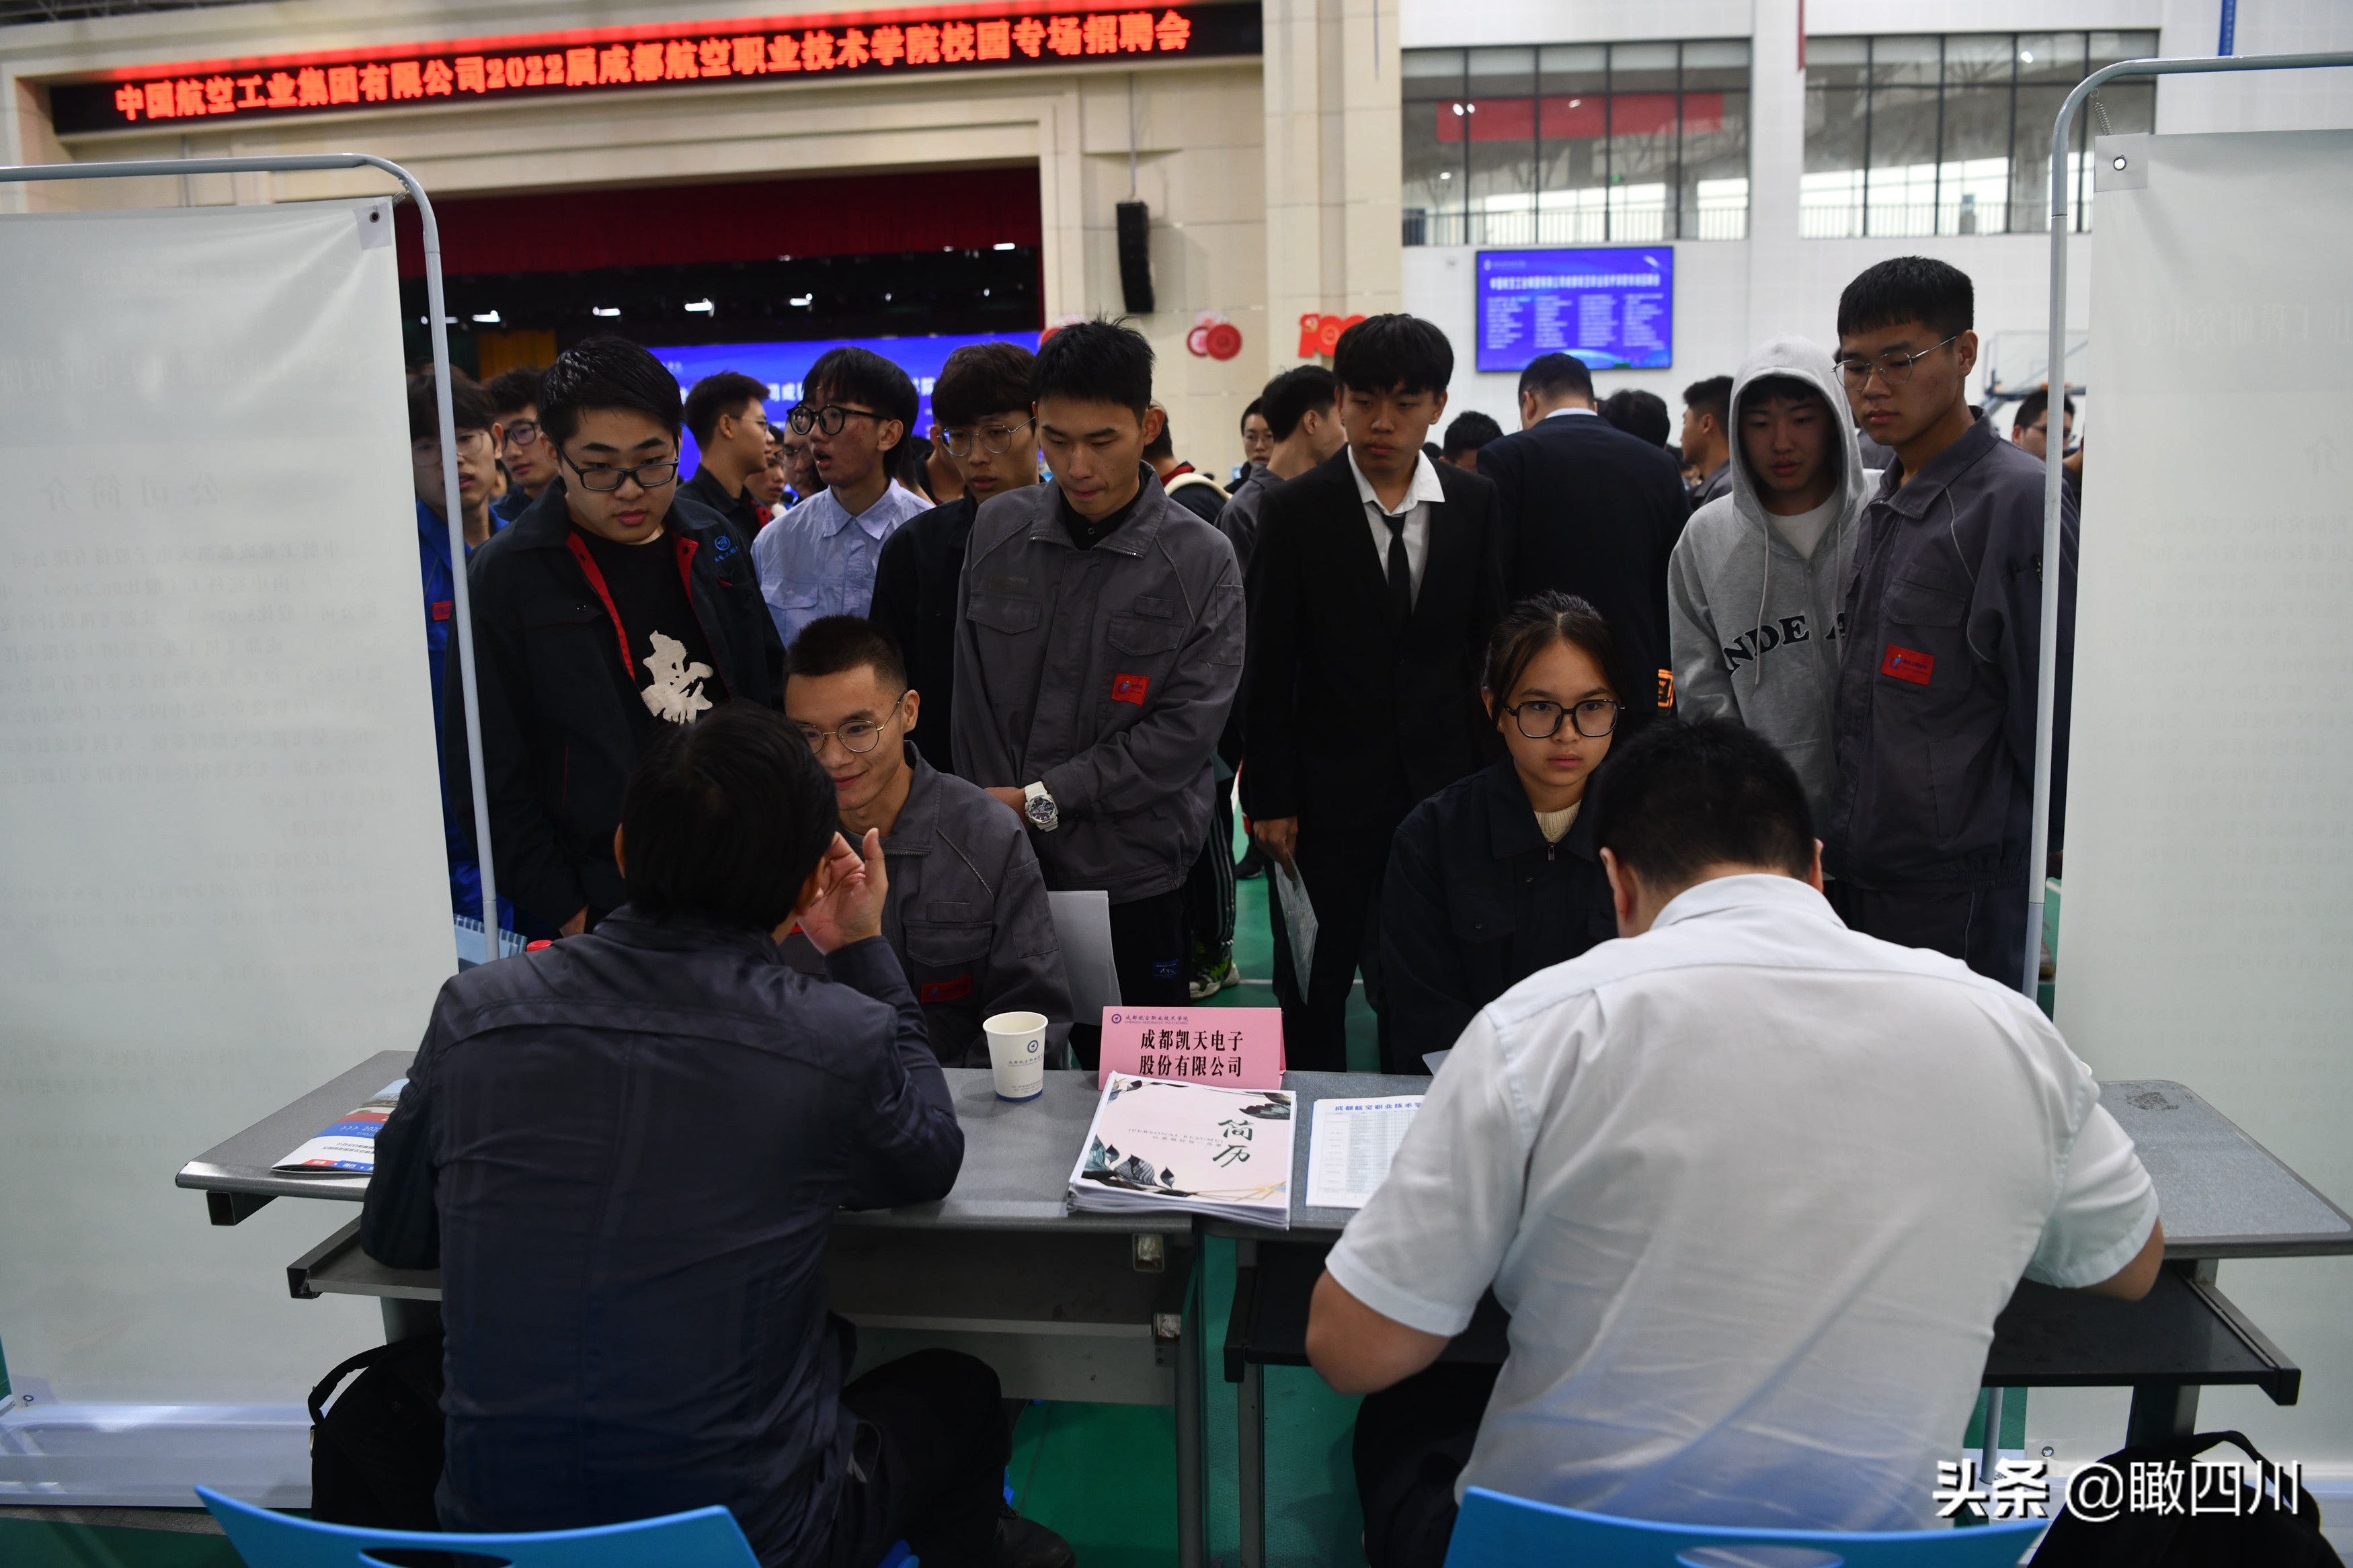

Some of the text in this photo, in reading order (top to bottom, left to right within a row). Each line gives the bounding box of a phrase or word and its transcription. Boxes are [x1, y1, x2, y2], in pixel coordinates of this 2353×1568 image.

[115, 9, 1191, 122] 中国航空工业集团有限公司2022届成都航空职业技术学院校园专场招聘会
[1140, 1029, 1244, 1052] 成都凯天电子
[1139, 1055, 1243, 1077] 股份有限公司
[1212, 1118, 1255, 1168] 简历
